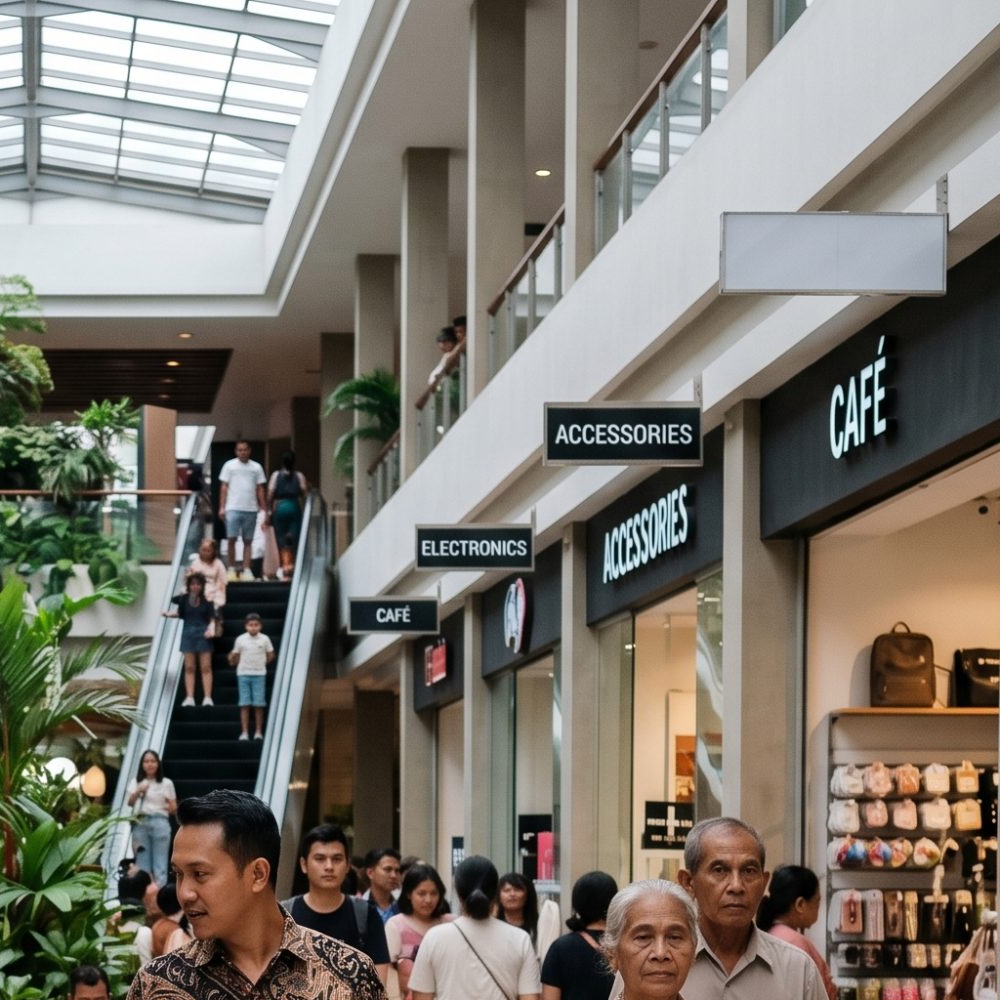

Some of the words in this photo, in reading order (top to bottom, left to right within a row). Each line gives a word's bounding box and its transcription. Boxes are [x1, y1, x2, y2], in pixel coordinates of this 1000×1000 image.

[829, 334, 887, 460] CAFÉ
[555, 423, 693, 445] ACCESSORIES
[602, 483, 689, 584] ACCESSORIES
[421, 539, 527, 556] ELECTRONICS
[376, 604, 413, 623] CAFÉ
